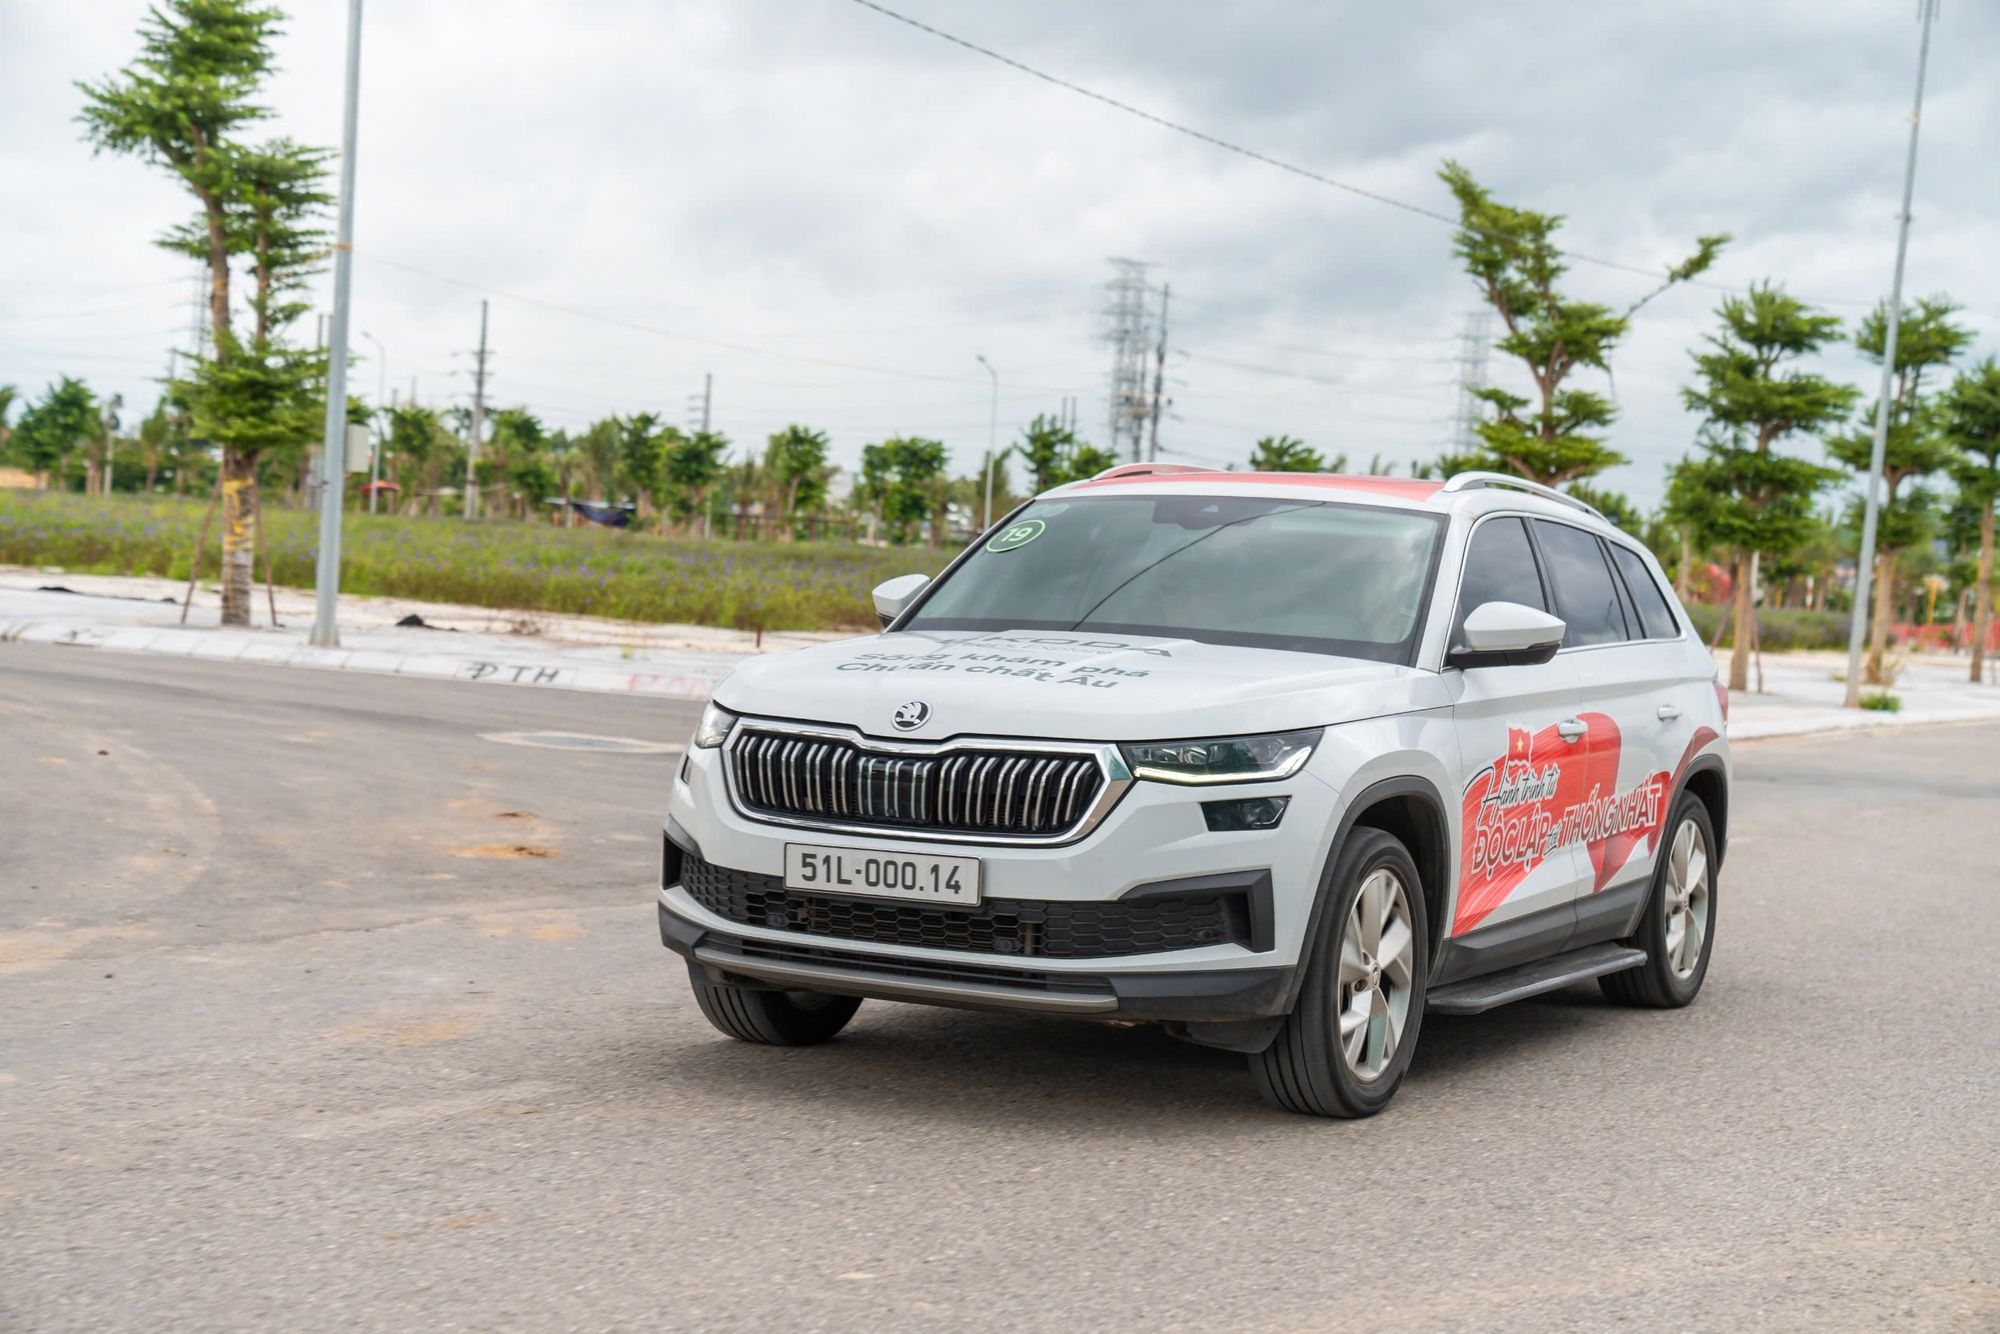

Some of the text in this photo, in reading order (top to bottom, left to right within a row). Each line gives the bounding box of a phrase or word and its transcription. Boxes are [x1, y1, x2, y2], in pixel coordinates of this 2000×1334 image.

[1001, 527, 1033, 542] 19
[960, 653, 1066, 667] khám
[1070, 666, 1152, 678] phá
[1057, 675, 1119, 689] Âu
[802, 853, 962, 894] 51L-000.14
